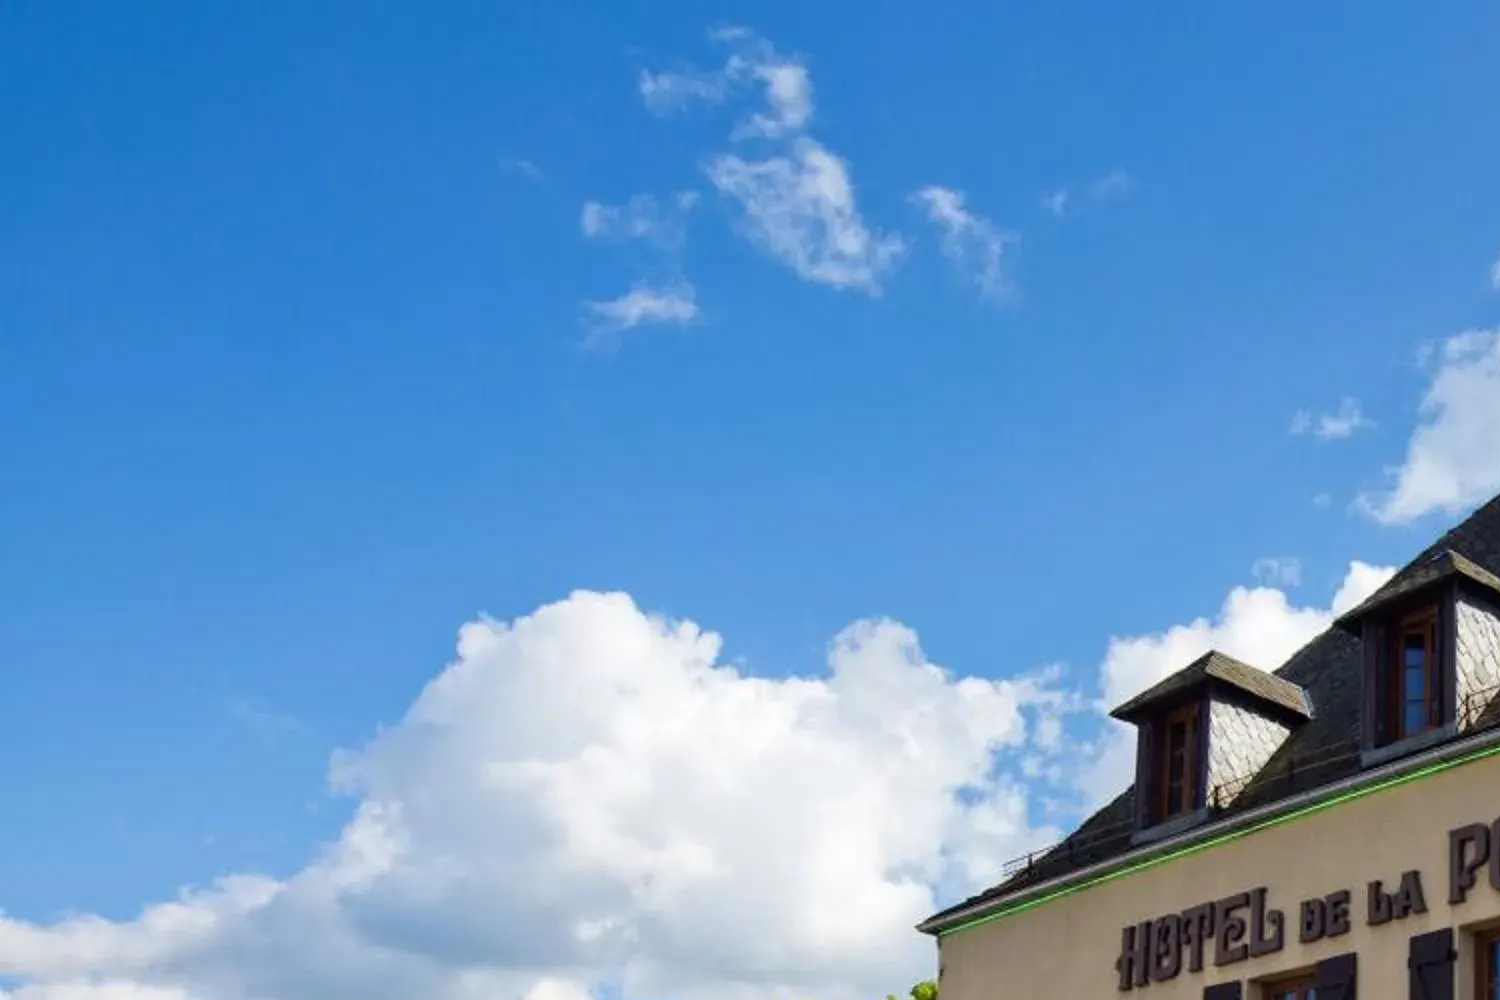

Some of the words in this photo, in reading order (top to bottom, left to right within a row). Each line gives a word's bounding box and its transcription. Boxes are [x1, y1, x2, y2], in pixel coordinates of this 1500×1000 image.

[1117, 887, 1284, 991] HOTEL
[1299, 889, 1351, 943] DE
[1366, 870, 1428, 926] LA
